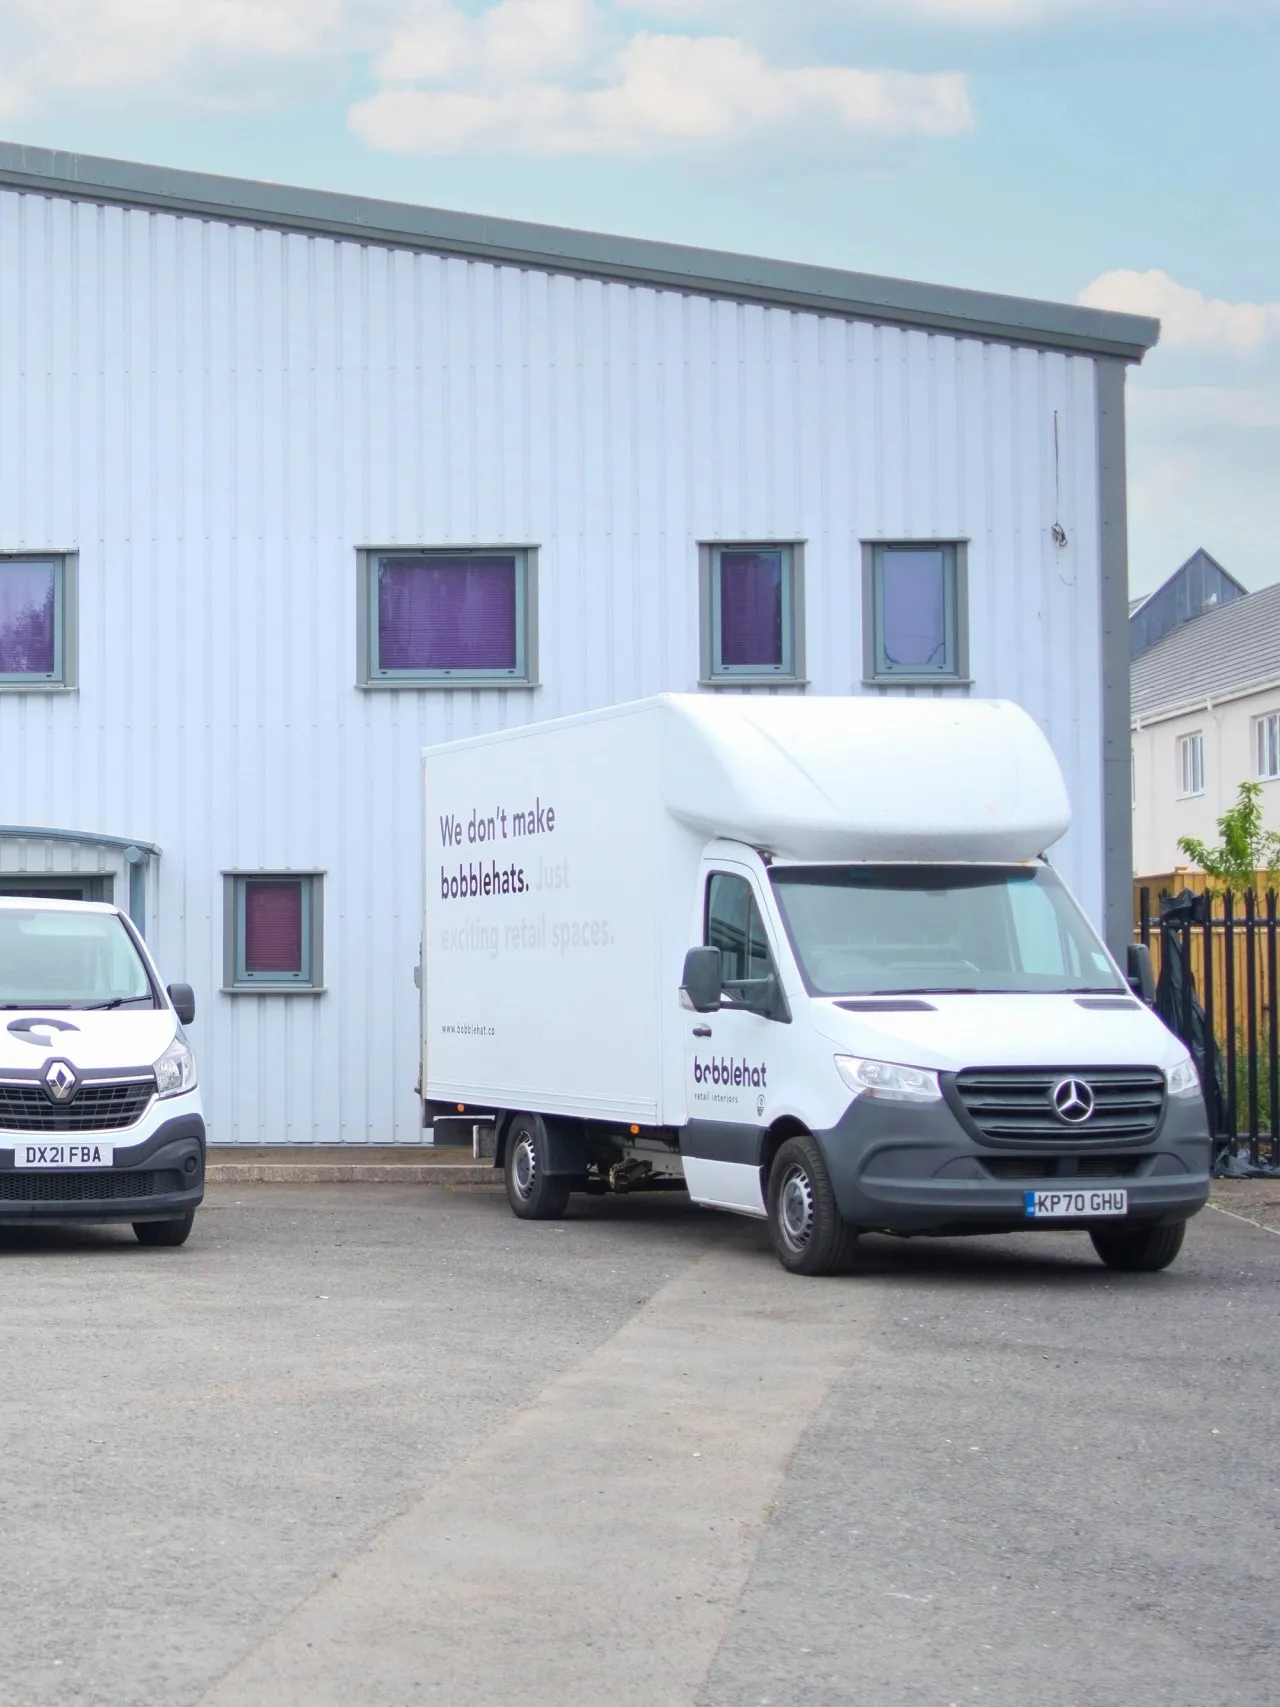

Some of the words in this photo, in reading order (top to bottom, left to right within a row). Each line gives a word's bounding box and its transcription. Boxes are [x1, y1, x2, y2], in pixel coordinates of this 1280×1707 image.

[439, 813, 463, 847] We
[467, 806, 508, 844] don't
[512, 797, 556, 838] make
[440, 860, 530, 900] bobblehats.
[535, 855, 570, 892] Just
[440, 915, 499, 960] exciting
[504, 911, 546, 951] retail
[551, 919, 615, 959] spaces.
[694, 1055, 767, 1088] bobblehat
[694, 1091, 710, 1101] retail
[711, 1093, 738, 1104] interiors
[25, 1147, 64, 1163] DX21
[69, 1146, 102, 1162] FBA
[1038, 1194, 1085, 1212] KP70
[1090, 1193, 1124, 1211] GHU
